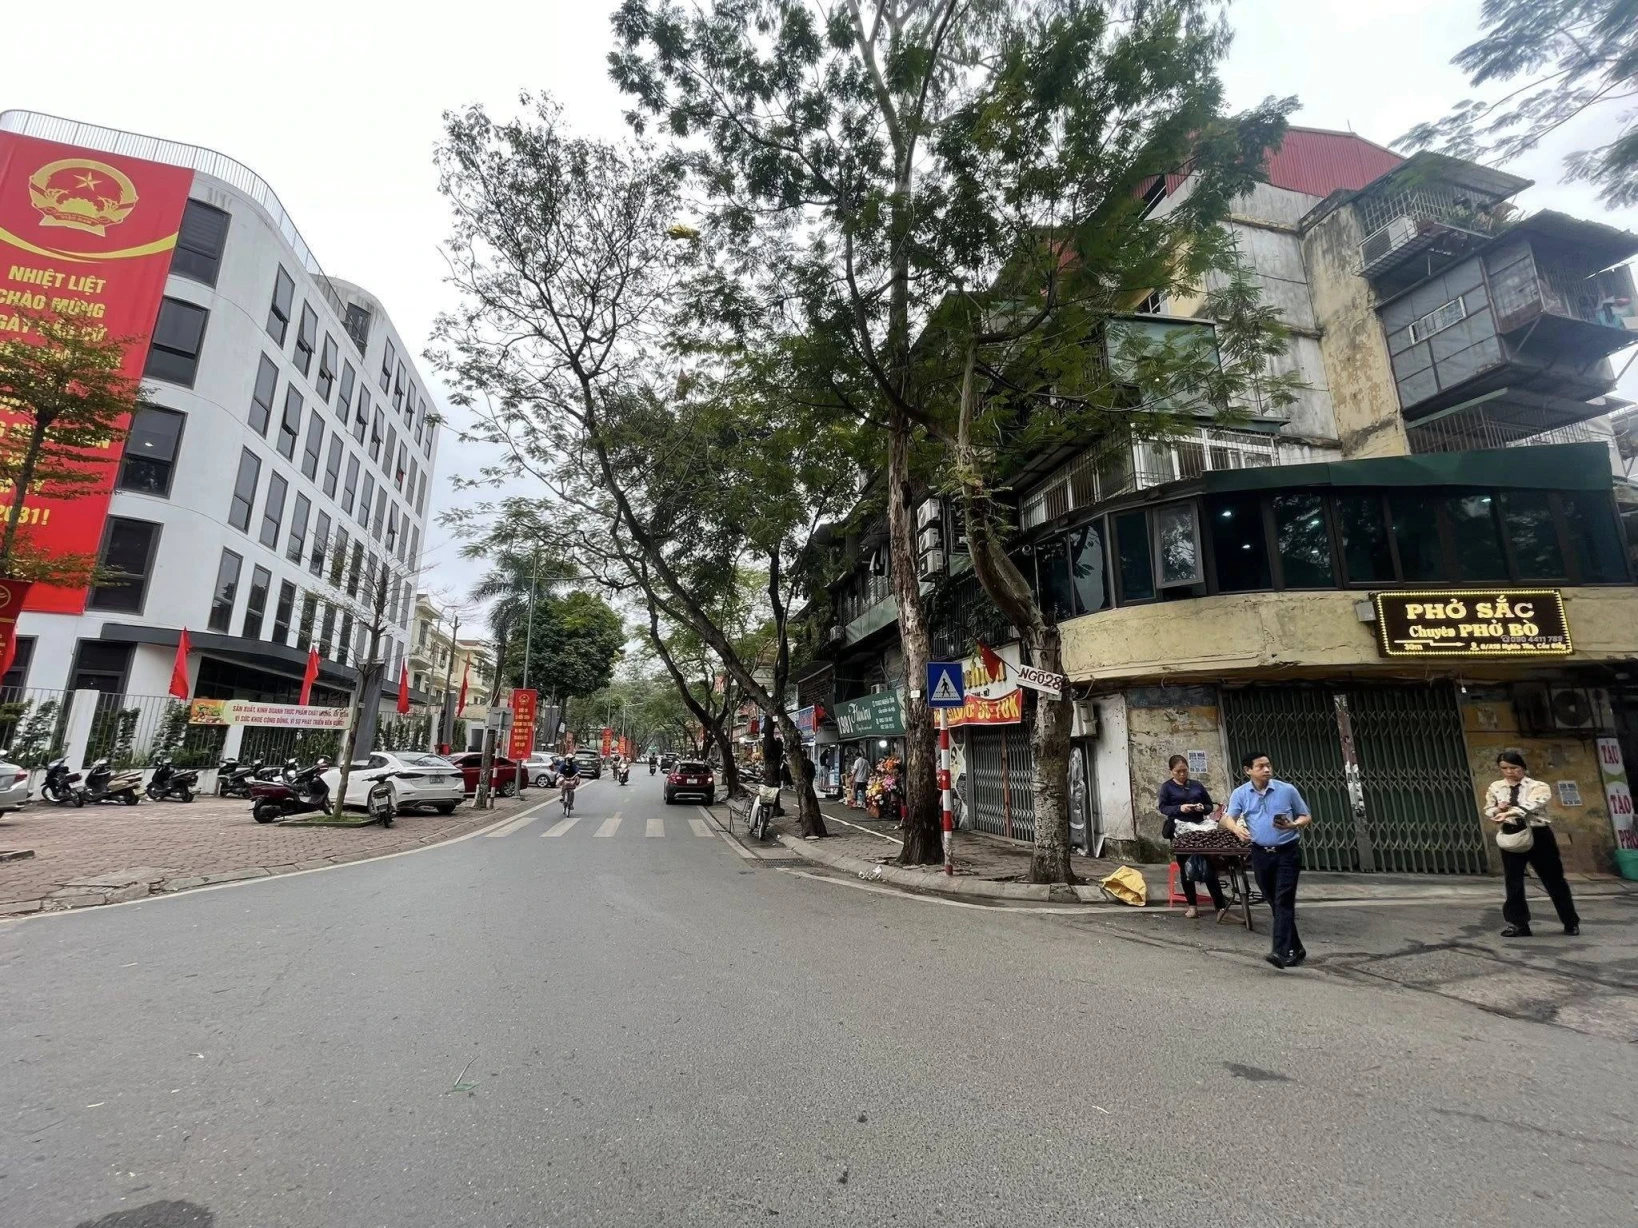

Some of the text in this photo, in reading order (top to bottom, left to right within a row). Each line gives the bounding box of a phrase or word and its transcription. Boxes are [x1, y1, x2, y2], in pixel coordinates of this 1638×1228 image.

[8, 265, 106, 295] NHIỆT LIỆT
[1405, 594, 1535, 619] PHỞ SẮC
[1409, 619, 1539, 639] Chuyên PHỞ BÒ
[1601, 740, 1619, 764] TÀU
[1610, 788, 1632, 814] TÀO
